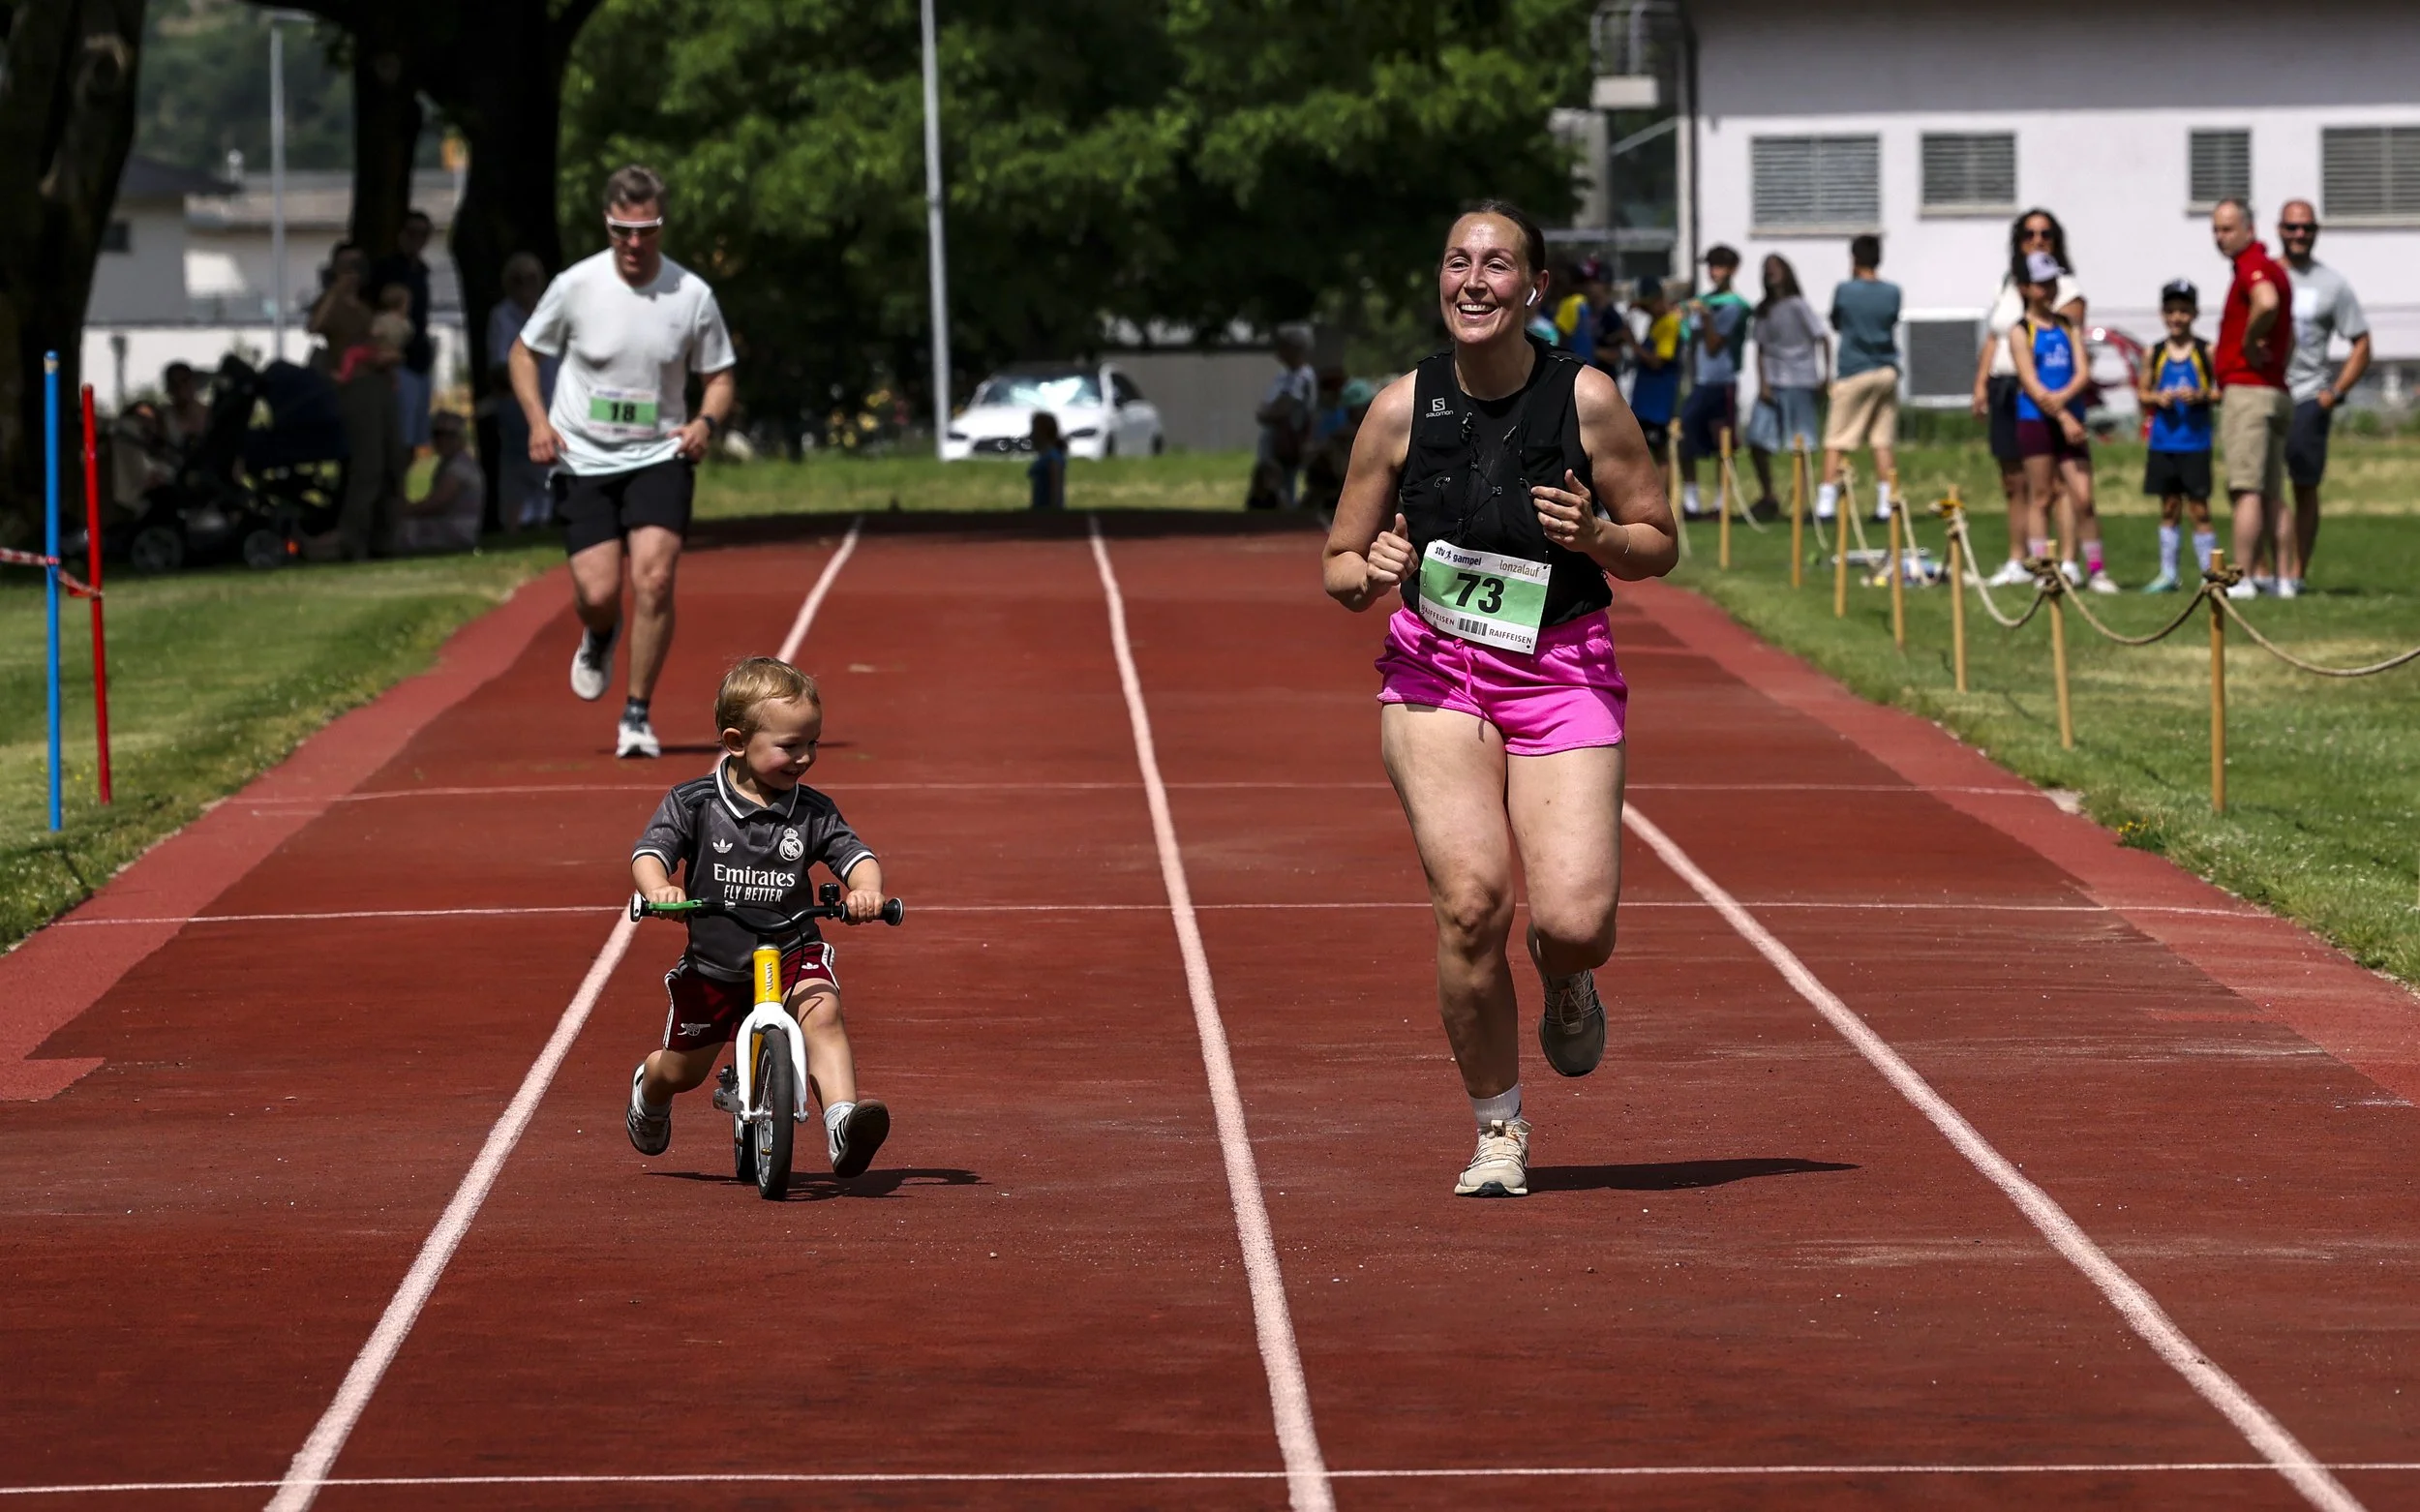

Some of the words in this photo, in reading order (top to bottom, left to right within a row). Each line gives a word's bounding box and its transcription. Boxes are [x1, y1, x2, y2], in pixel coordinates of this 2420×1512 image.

[610, 402, 636, 423] 18
[1435, 546, 1445, 557] stv
[1453, 553, 1482, 566] gampel
[1499, 559, 1541, 578] lonzalauf
[1456, 572, 1504, 614] 73
[1421, 604, 1455, 626] RAIFFEISEN
[1489, 628, 1532, 645] RAIFFEISEN
[713, 862, 796, 888] Emirates
[723, 885, 742, 900] FLY
[744, 887, 783, 903] BETTER
